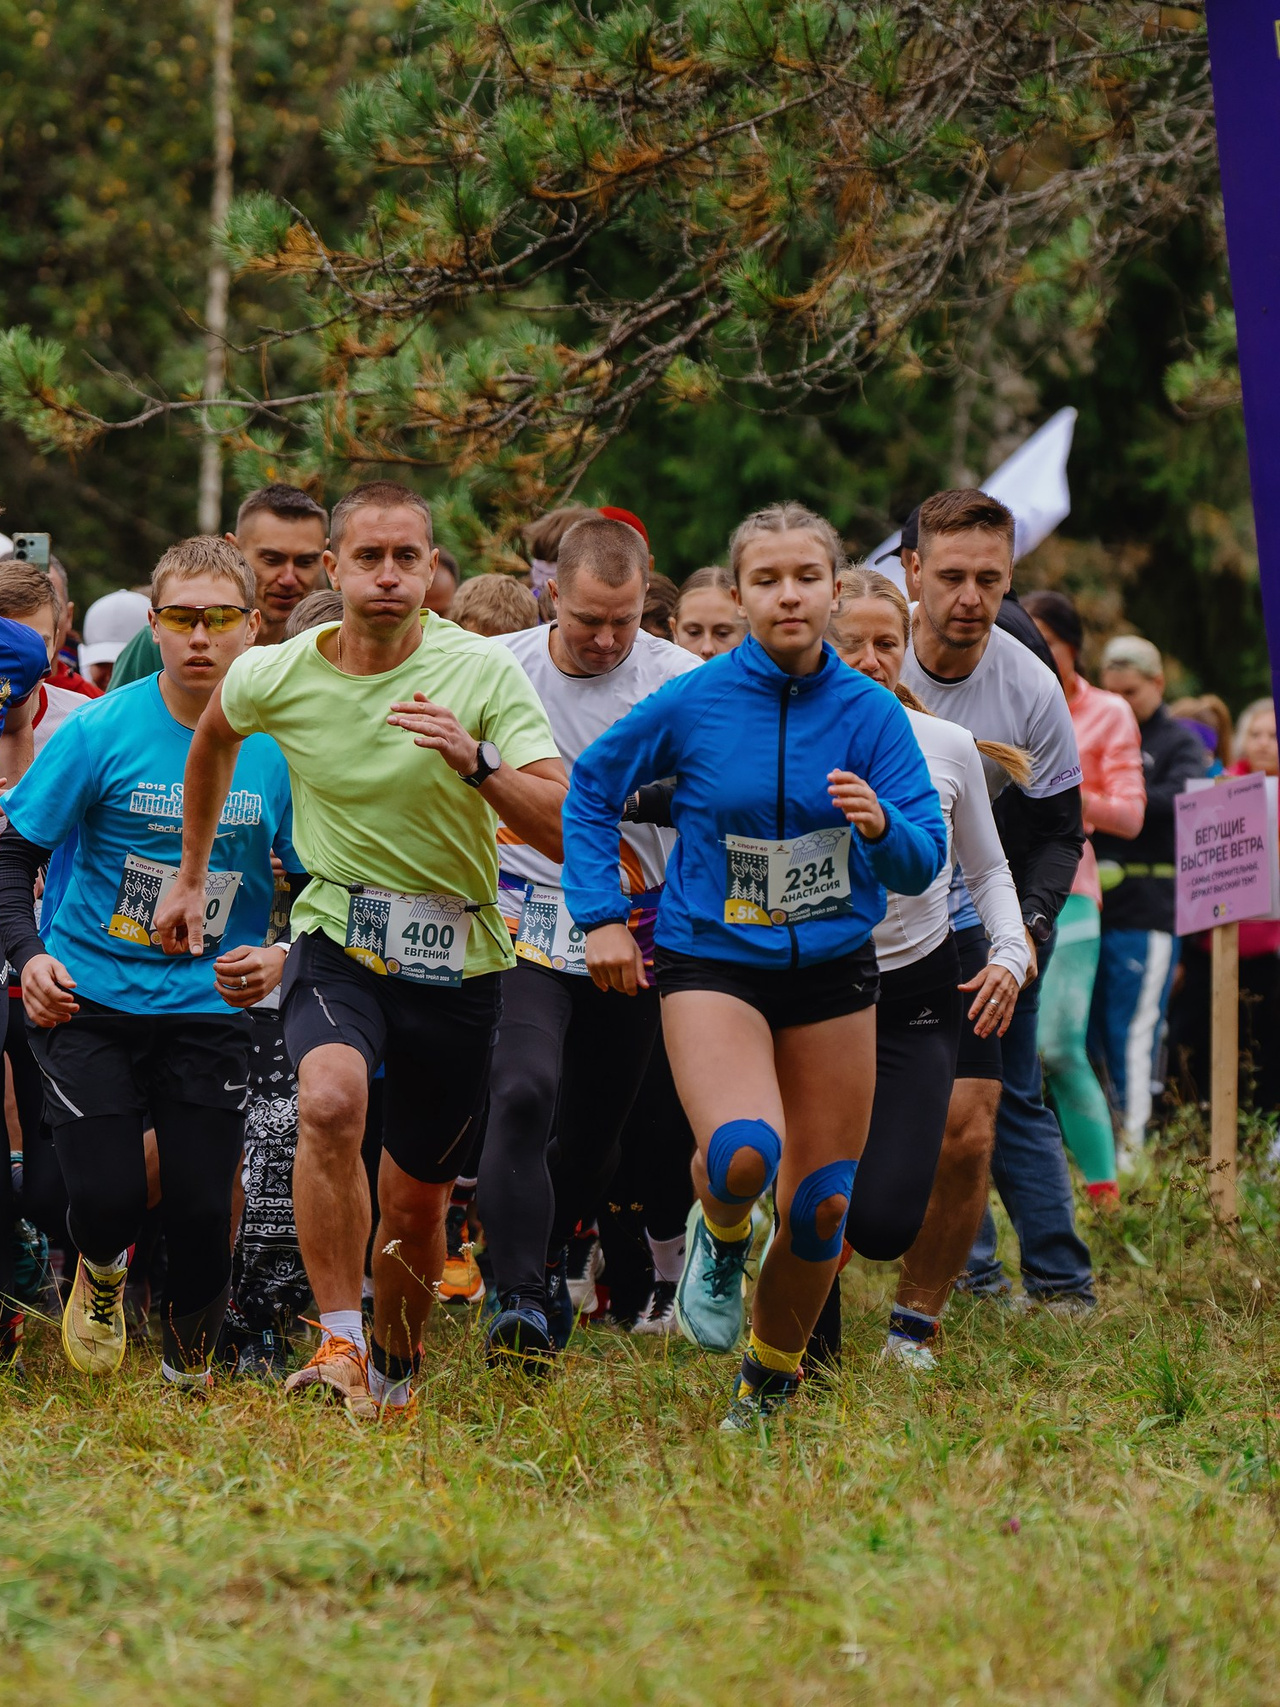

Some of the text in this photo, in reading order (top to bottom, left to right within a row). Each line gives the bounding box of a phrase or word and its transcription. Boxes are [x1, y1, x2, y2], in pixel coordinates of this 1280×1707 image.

[137, 782, 166, 791] 2012
[1196, 817, 1245, 846] БЕГУЩИЕ
[1181, 835, 1264, 872] БЫСТРЕЕ ВЕТРА
[785, 857, 835, 893] 234
[780, 880, 840, 904] АНАСТАСИЯ
[402, 922, 455, 950] 400
[404, 947, 450, 960] ЕВГЕНИЙ
[908, 1018, 940, 1026] DEMIX
